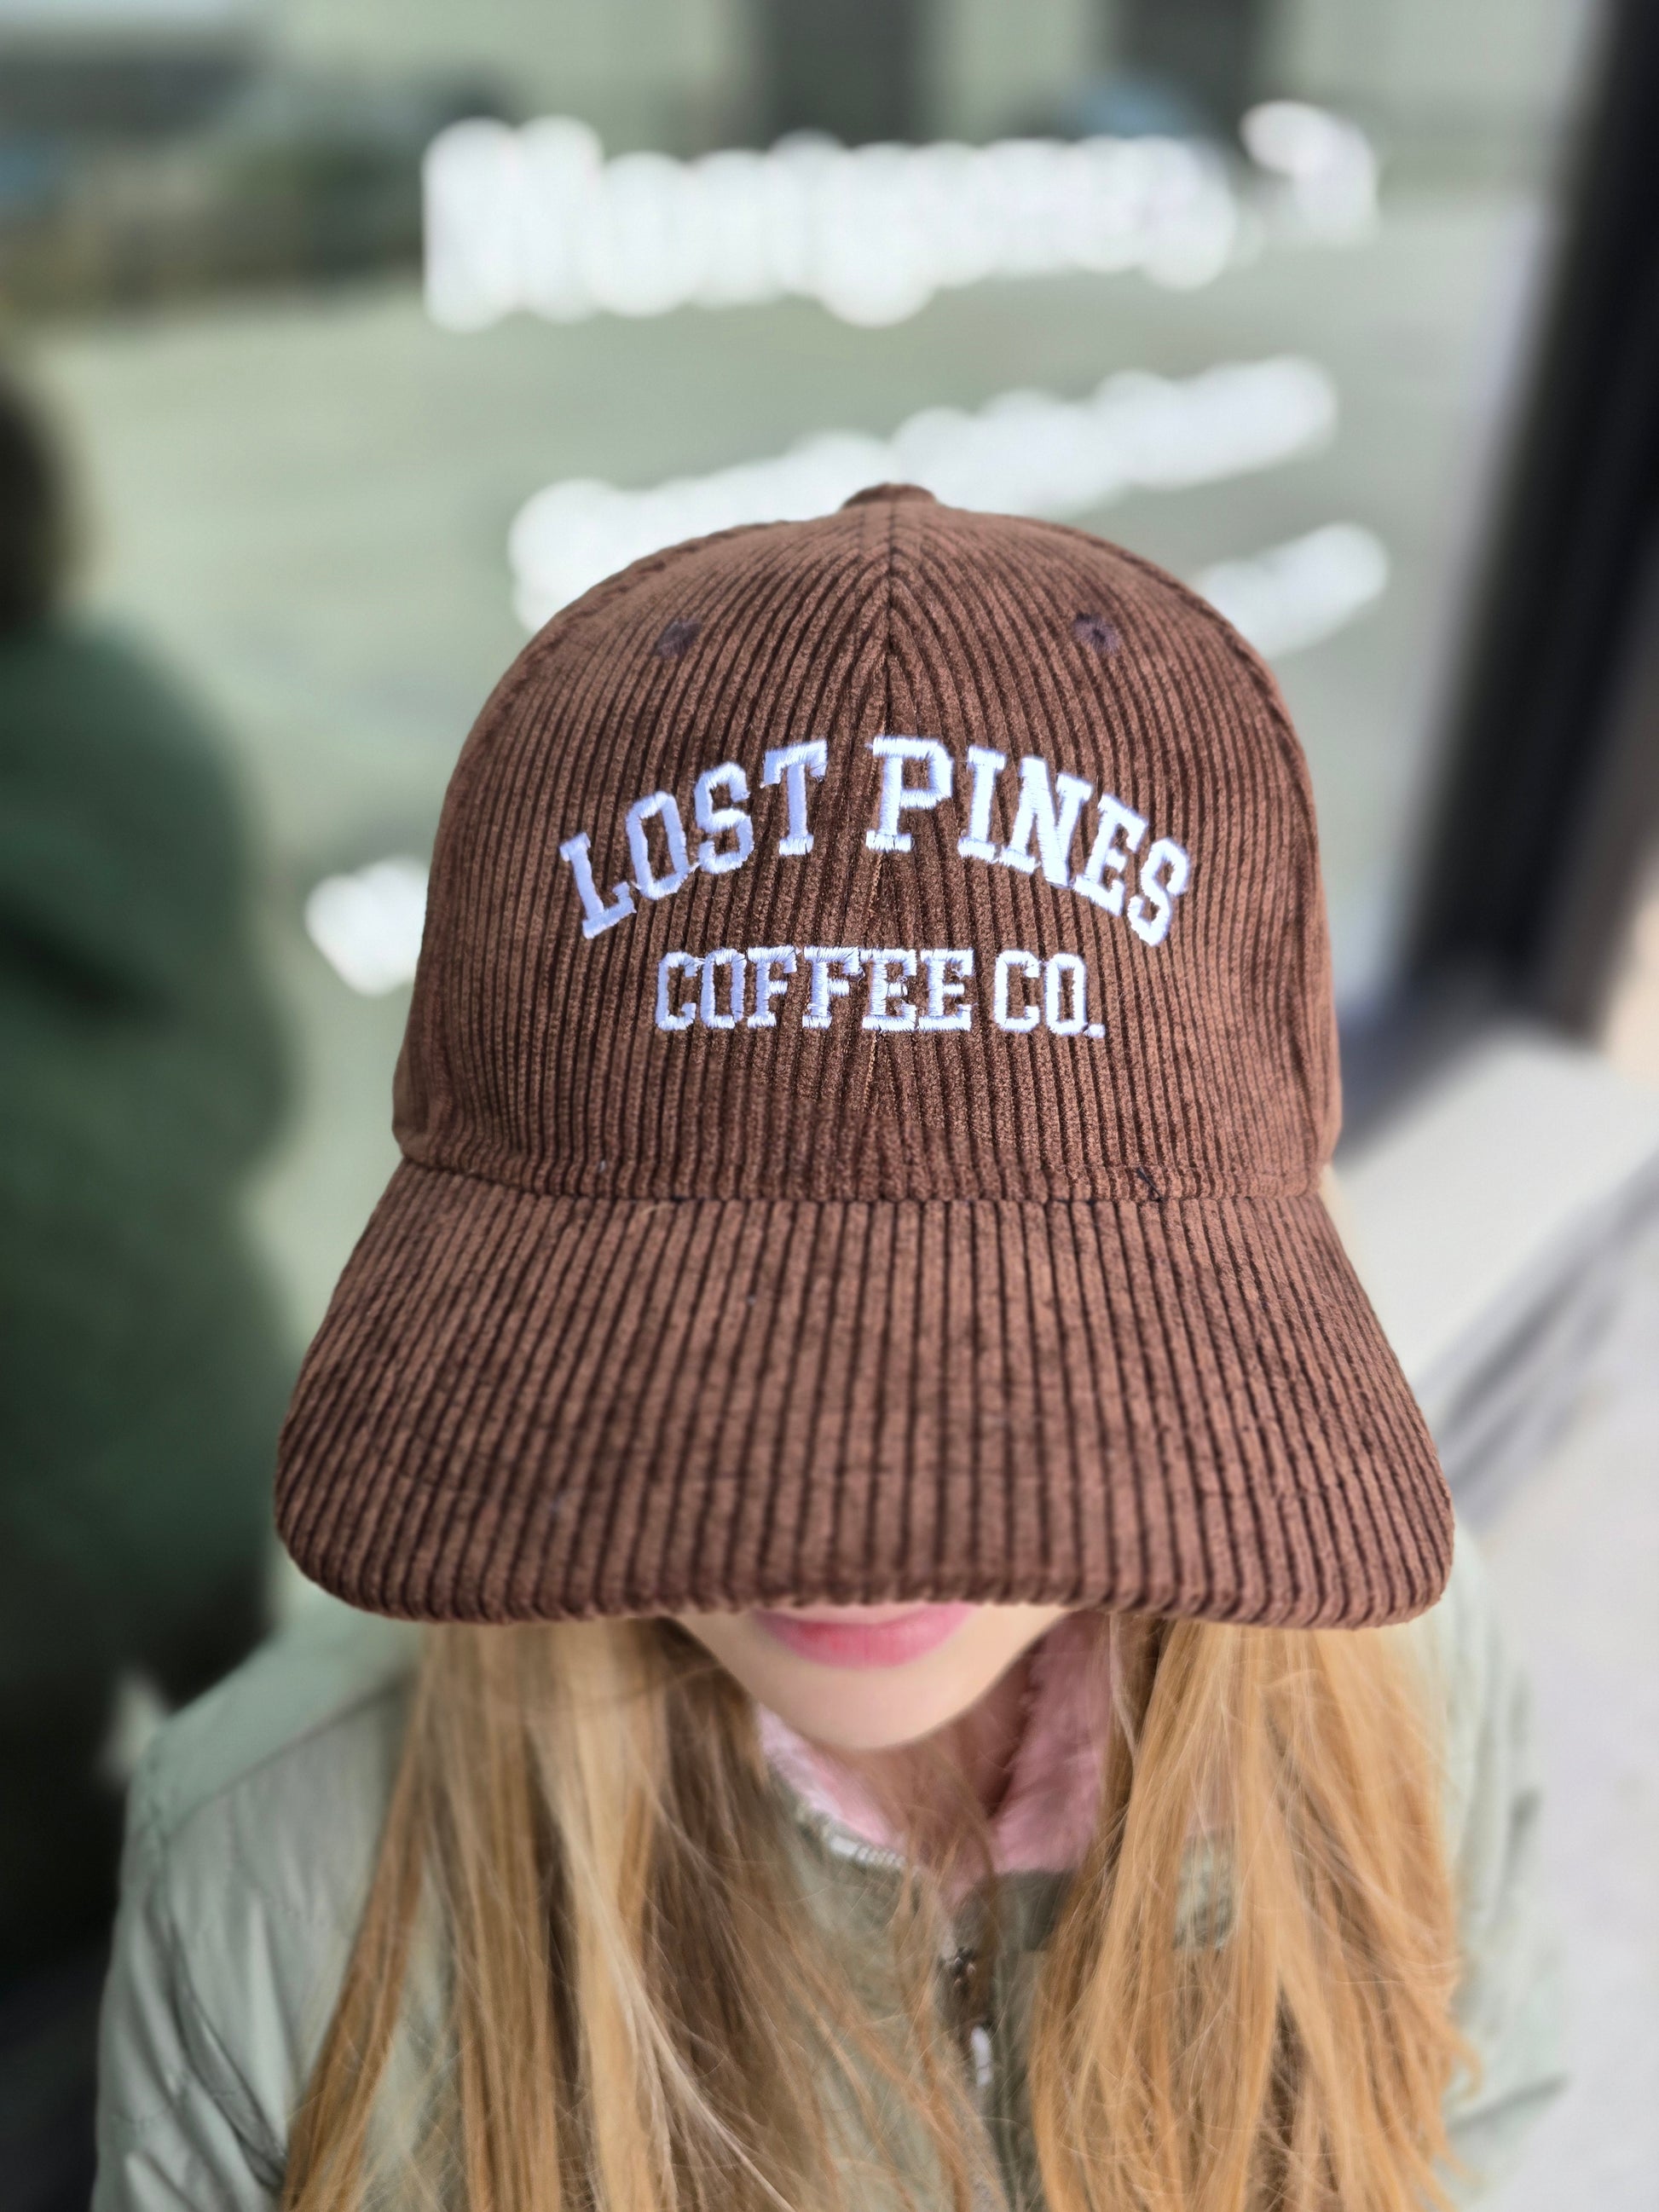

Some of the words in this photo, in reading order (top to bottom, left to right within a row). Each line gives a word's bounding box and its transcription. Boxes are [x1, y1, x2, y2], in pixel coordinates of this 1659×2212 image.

[559, 739, 828, 939] LOST
[864, 736, 1191, 947] PINES
[655, 945, 974, 1033] COFFEE
[992, 949, 1106, 1039] CO.
